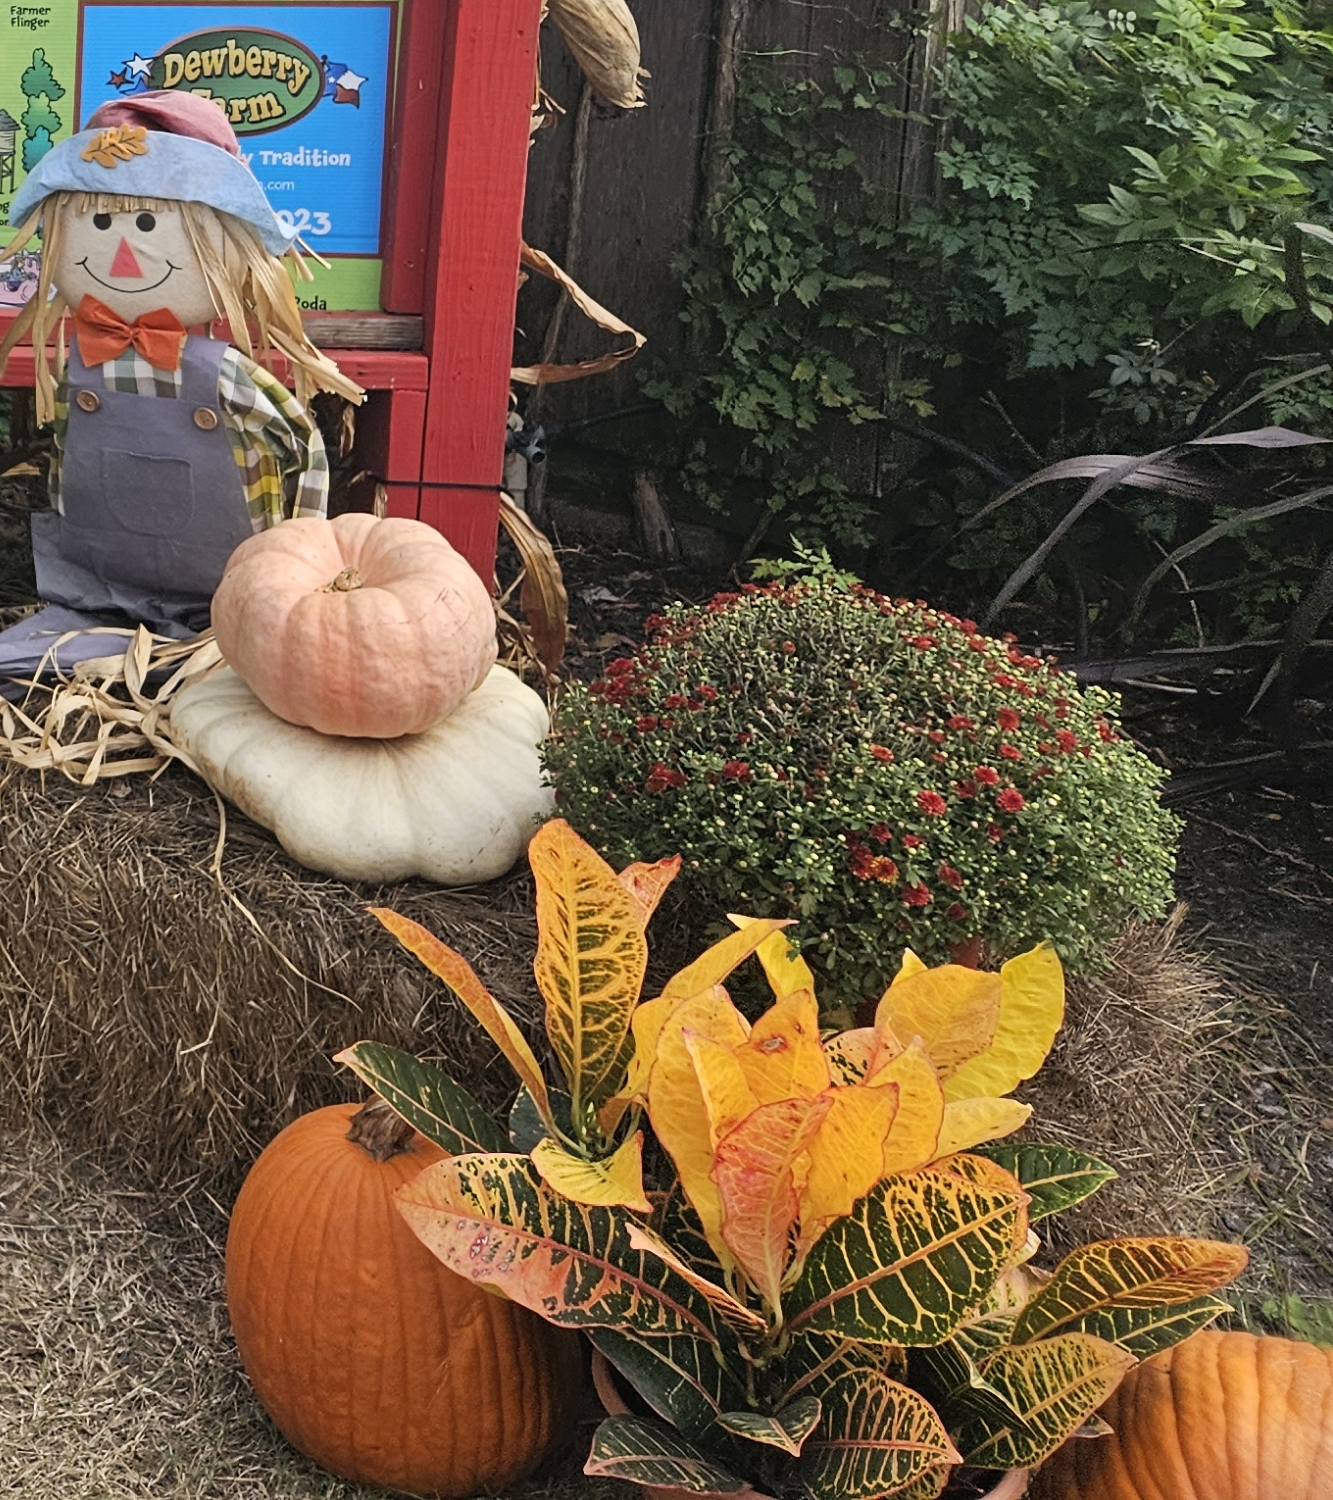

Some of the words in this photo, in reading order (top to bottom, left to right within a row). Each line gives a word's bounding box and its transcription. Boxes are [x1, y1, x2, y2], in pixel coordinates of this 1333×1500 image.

[11, 6, 51, 16] Farmer
[11, 17, 50, 29] Flinger
[164, 39, 311, 96] Dewberry
[259, 146, 351, 168] Tradition
[275, 208, 332, 235] 023
